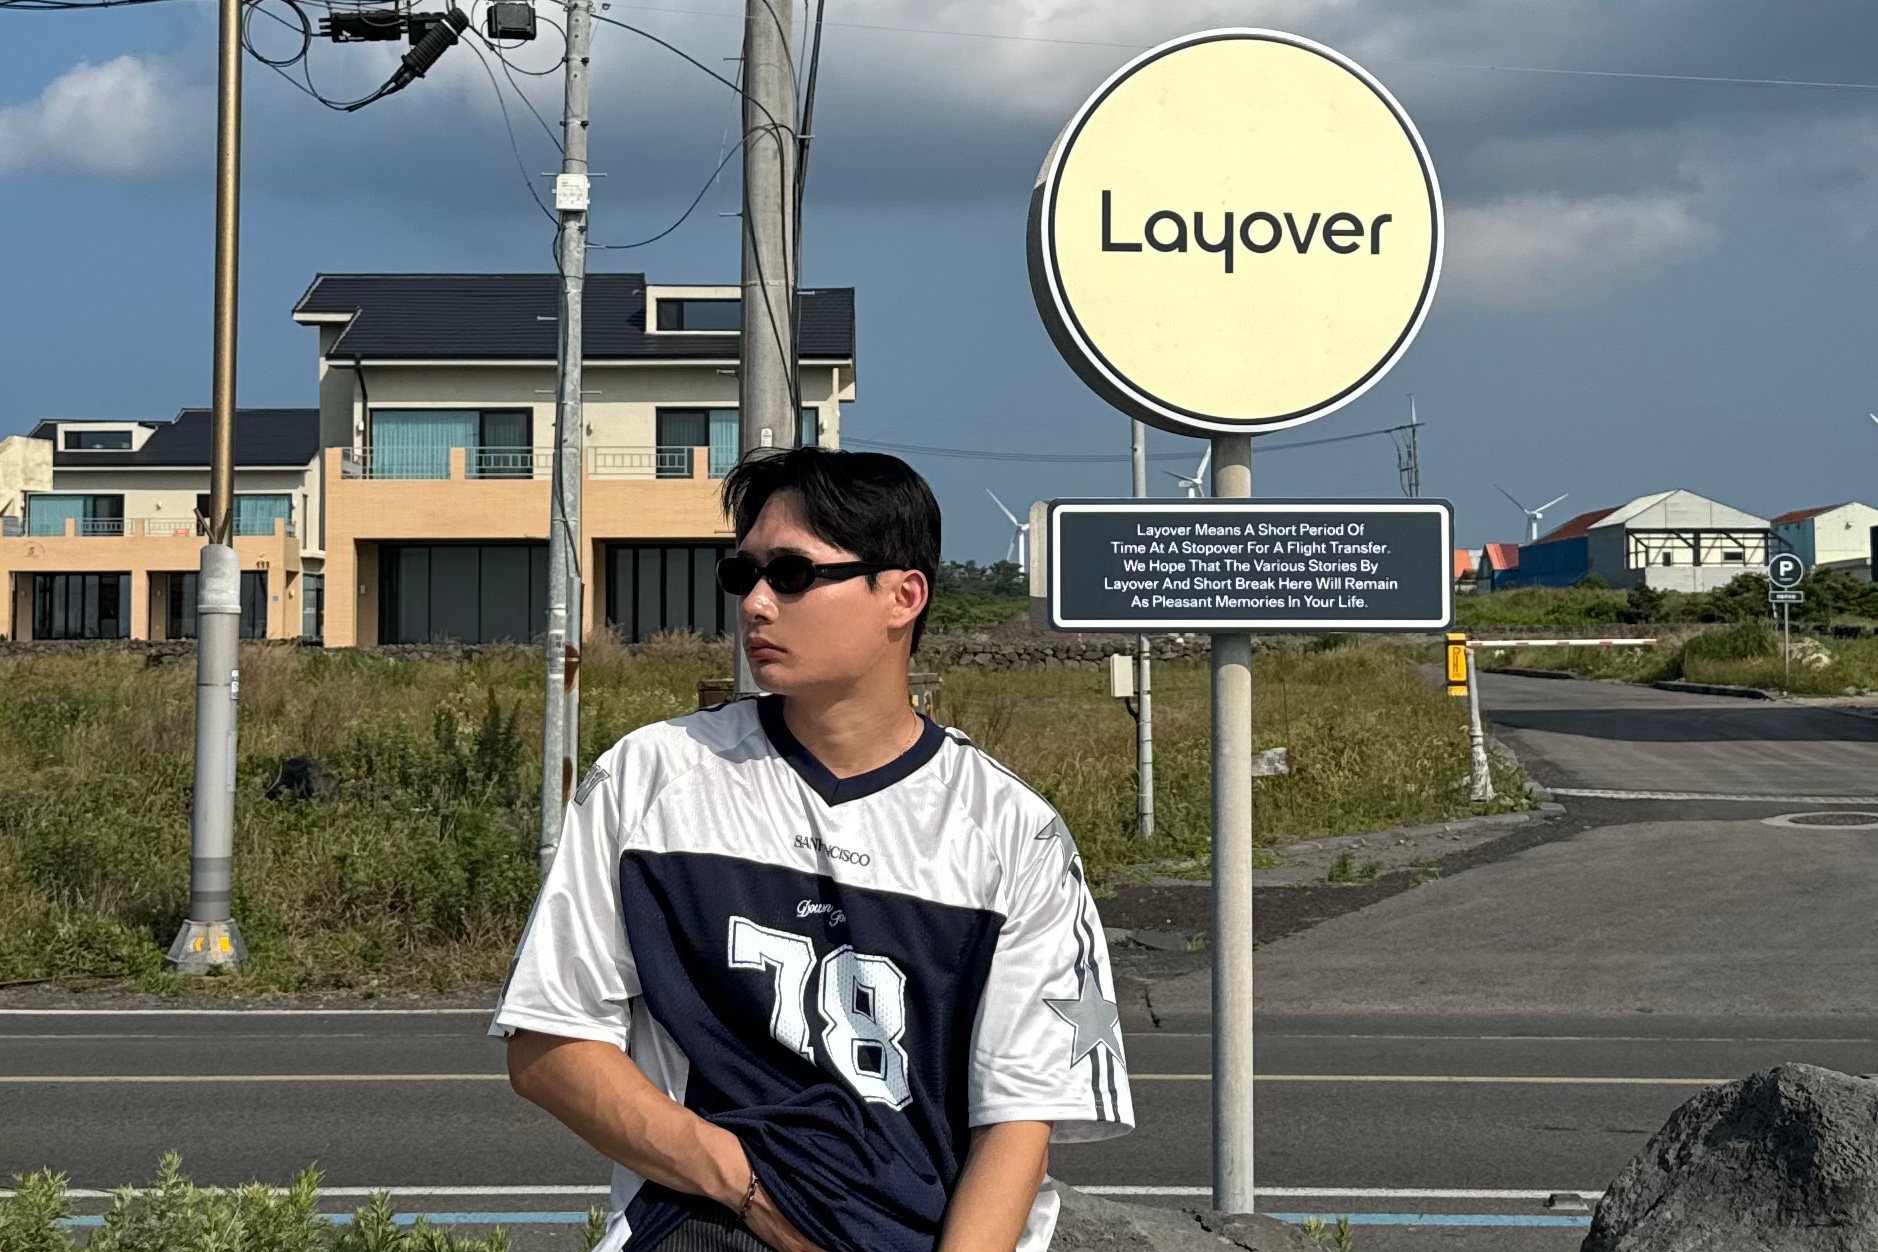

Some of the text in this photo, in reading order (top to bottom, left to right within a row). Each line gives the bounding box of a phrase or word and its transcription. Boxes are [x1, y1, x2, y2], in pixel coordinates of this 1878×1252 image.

[1101, 189, 1393, 273] Layover
[1136, 522, 1366, 539] Layover Means A Short Period Of
[1109, 540, 1392, 557] Time At A Stopover For A Flight Transfer.
[1122, 558, 1379, 575] We Hope That The Various Stories By
[1779, 560, 1795, 578] P
[1104, 576, 1399, 593] Layover And Short Break Here Will Remain
[1130, 594, 1370, 608] As Pleasant Memories In Your Life.
[728, 915, 914, 1111] 78
